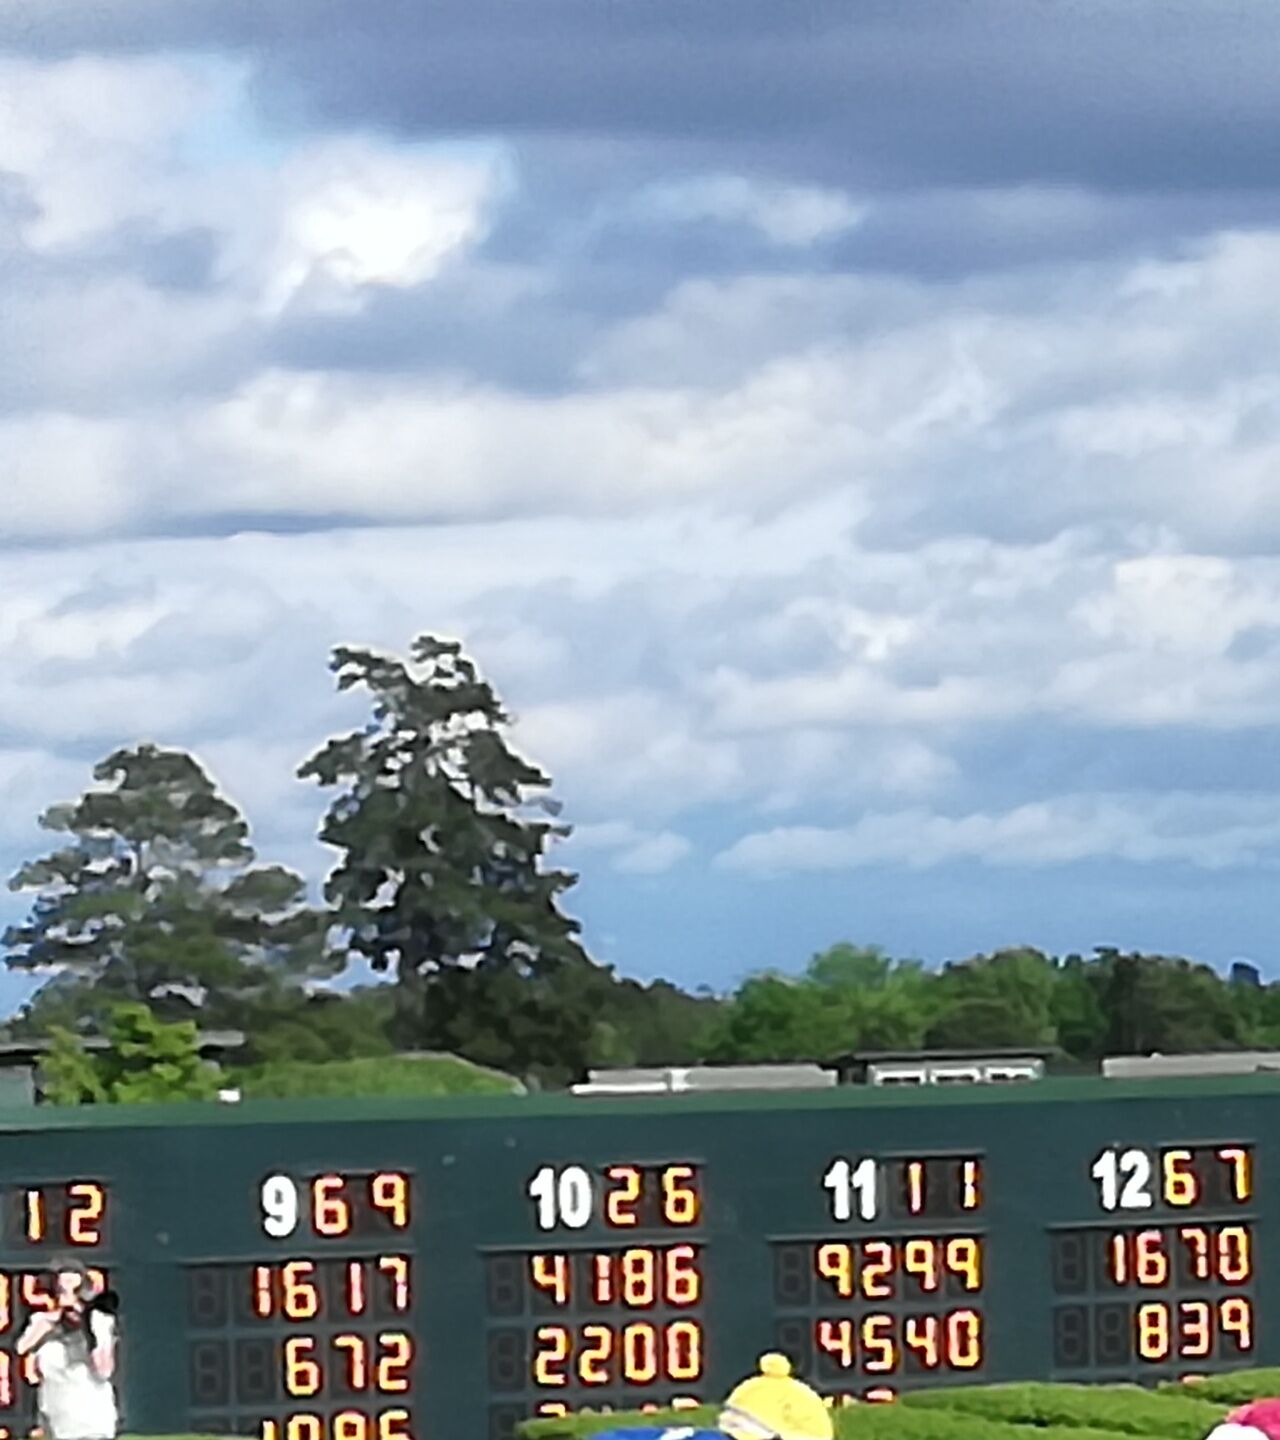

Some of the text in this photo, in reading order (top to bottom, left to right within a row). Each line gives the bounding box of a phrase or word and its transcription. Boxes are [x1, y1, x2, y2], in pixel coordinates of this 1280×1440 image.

[262, 1175, 298, 1236] 9
[529, 1166, 593, 1229] 10
[824, 1159, 876, 1220] 11
[1092, 1149, 1152, 1210] 12
[818, 1238, 979, 1297] 9299
[1113, 1226, 1249, 1284] 1670
[535, 1321, 700, 1385] 2200
[819, 1310, 980, 1371] 4540
[1138, 1298, 1250, 1358] 839
[285, 1334, 411, 1395] 672
